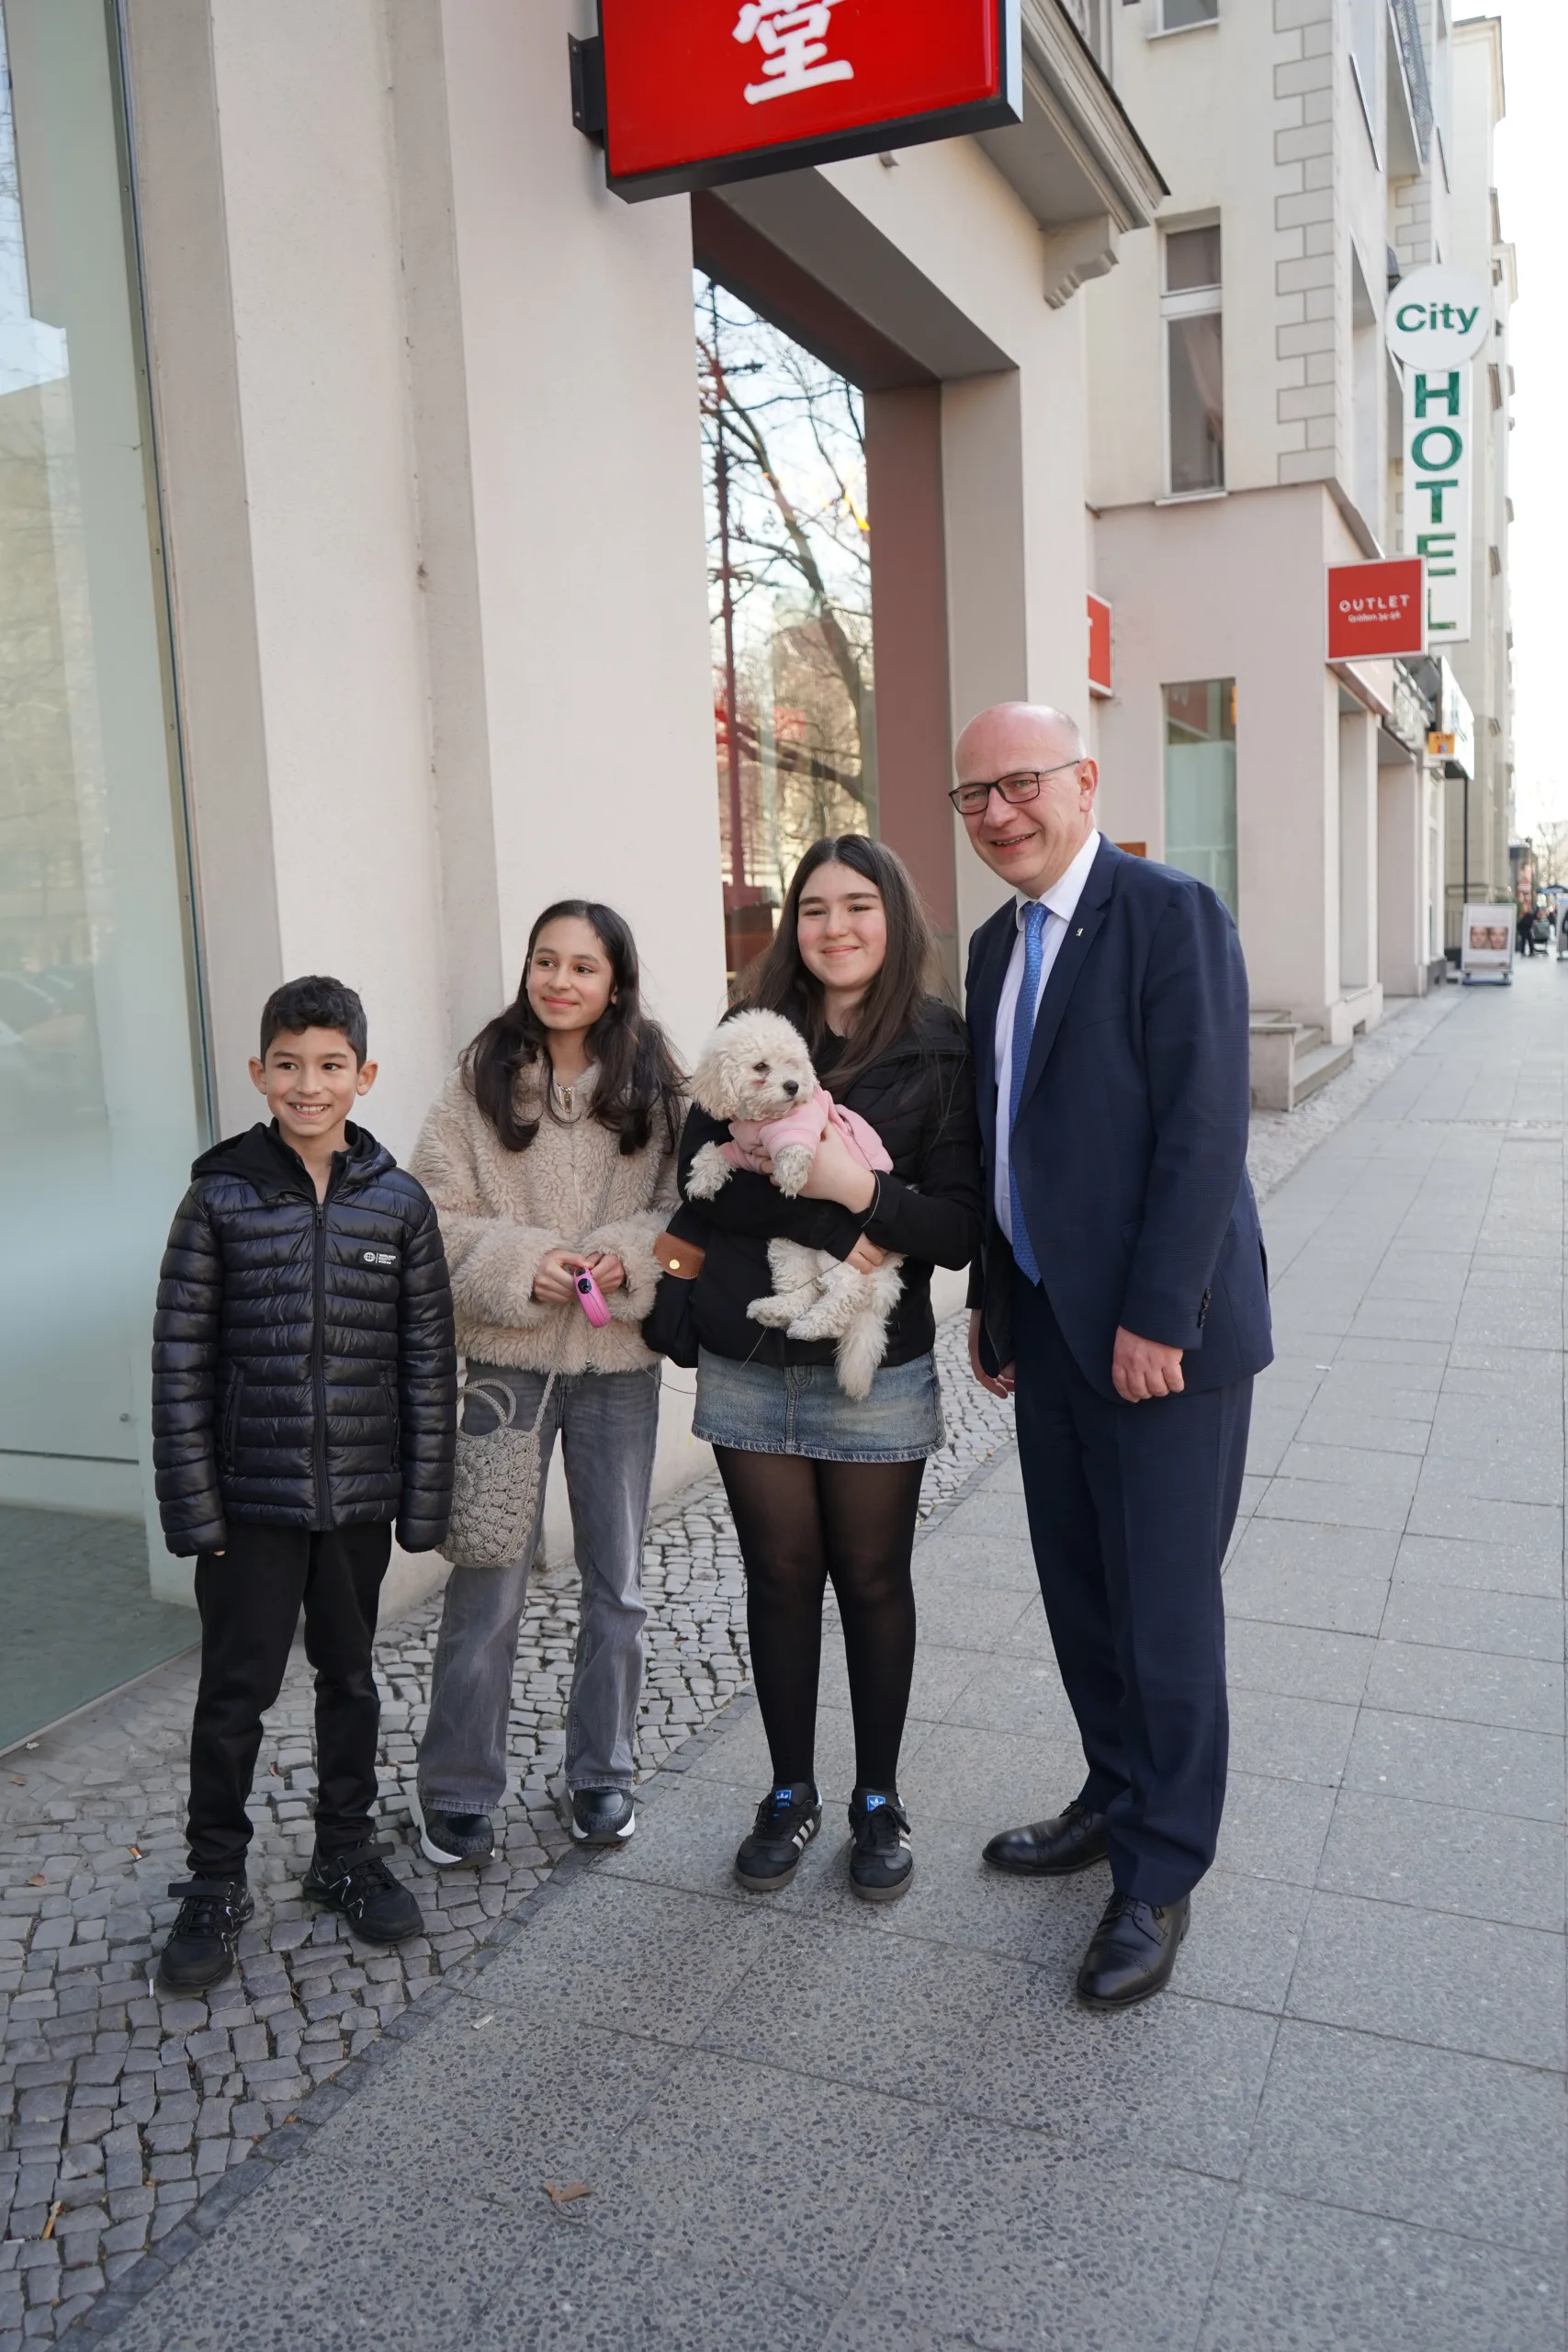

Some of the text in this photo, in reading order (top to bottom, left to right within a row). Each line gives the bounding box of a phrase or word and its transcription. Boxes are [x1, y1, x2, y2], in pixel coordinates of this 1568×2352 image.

[732, 0, 854, 105] 堂
[1395, 301, 1482, 334] City
[1410, 371, 1463, 630] HOTEL
[1338, 594, 1410, 613] OUTLET
